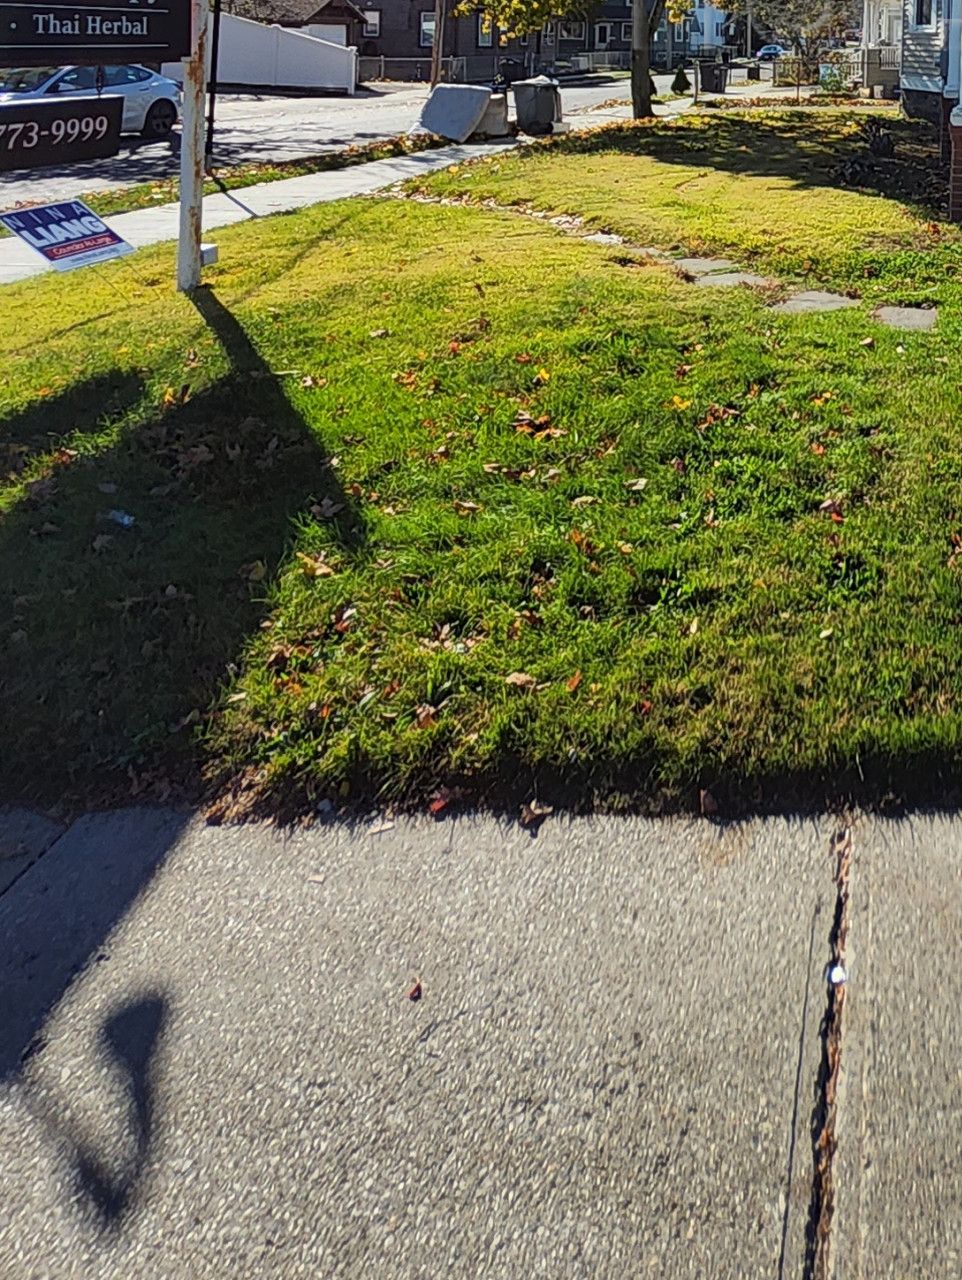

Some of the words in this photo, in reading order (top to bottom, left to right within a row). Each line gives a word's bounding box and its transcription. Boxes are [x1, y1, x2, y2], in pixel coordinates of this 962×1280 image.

[33, 14, 80, 35] Thai
[86, 16, 148, 36] Herbal
[3, 204, 88, 229] NINA
[19, 216, 107, 248] LIANG
